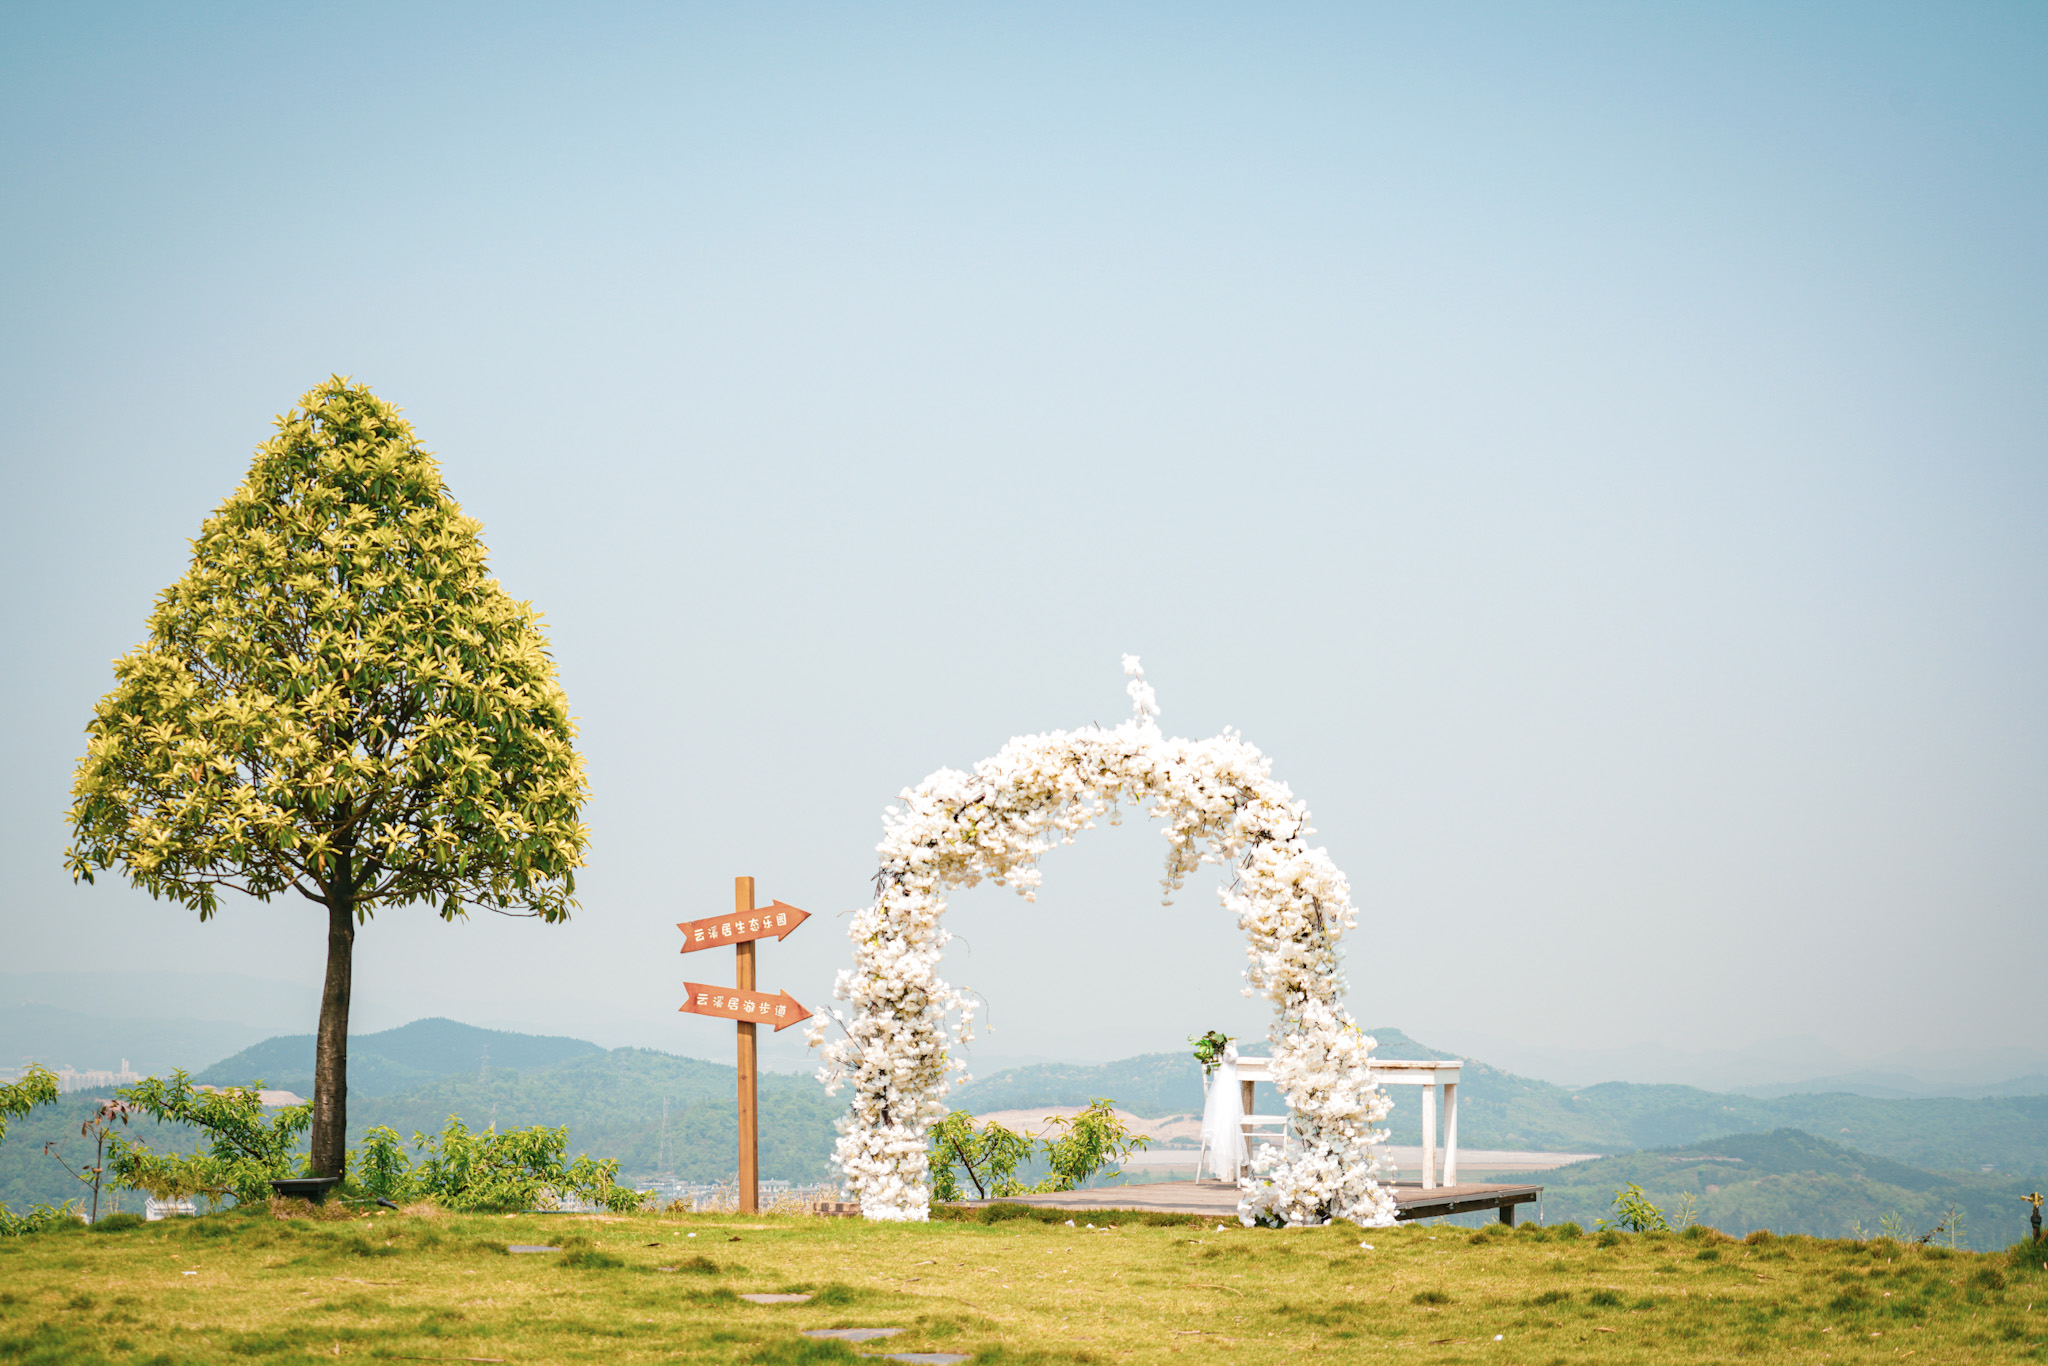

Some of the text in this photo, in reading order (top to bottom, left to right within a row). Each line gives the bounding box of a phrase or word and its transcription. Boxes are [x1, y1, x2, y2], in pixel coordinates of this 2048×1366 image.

[694, 913, 787, 942] 云溪居生态乐园
[696, 993, 787, 1018] 云溪居游步道
